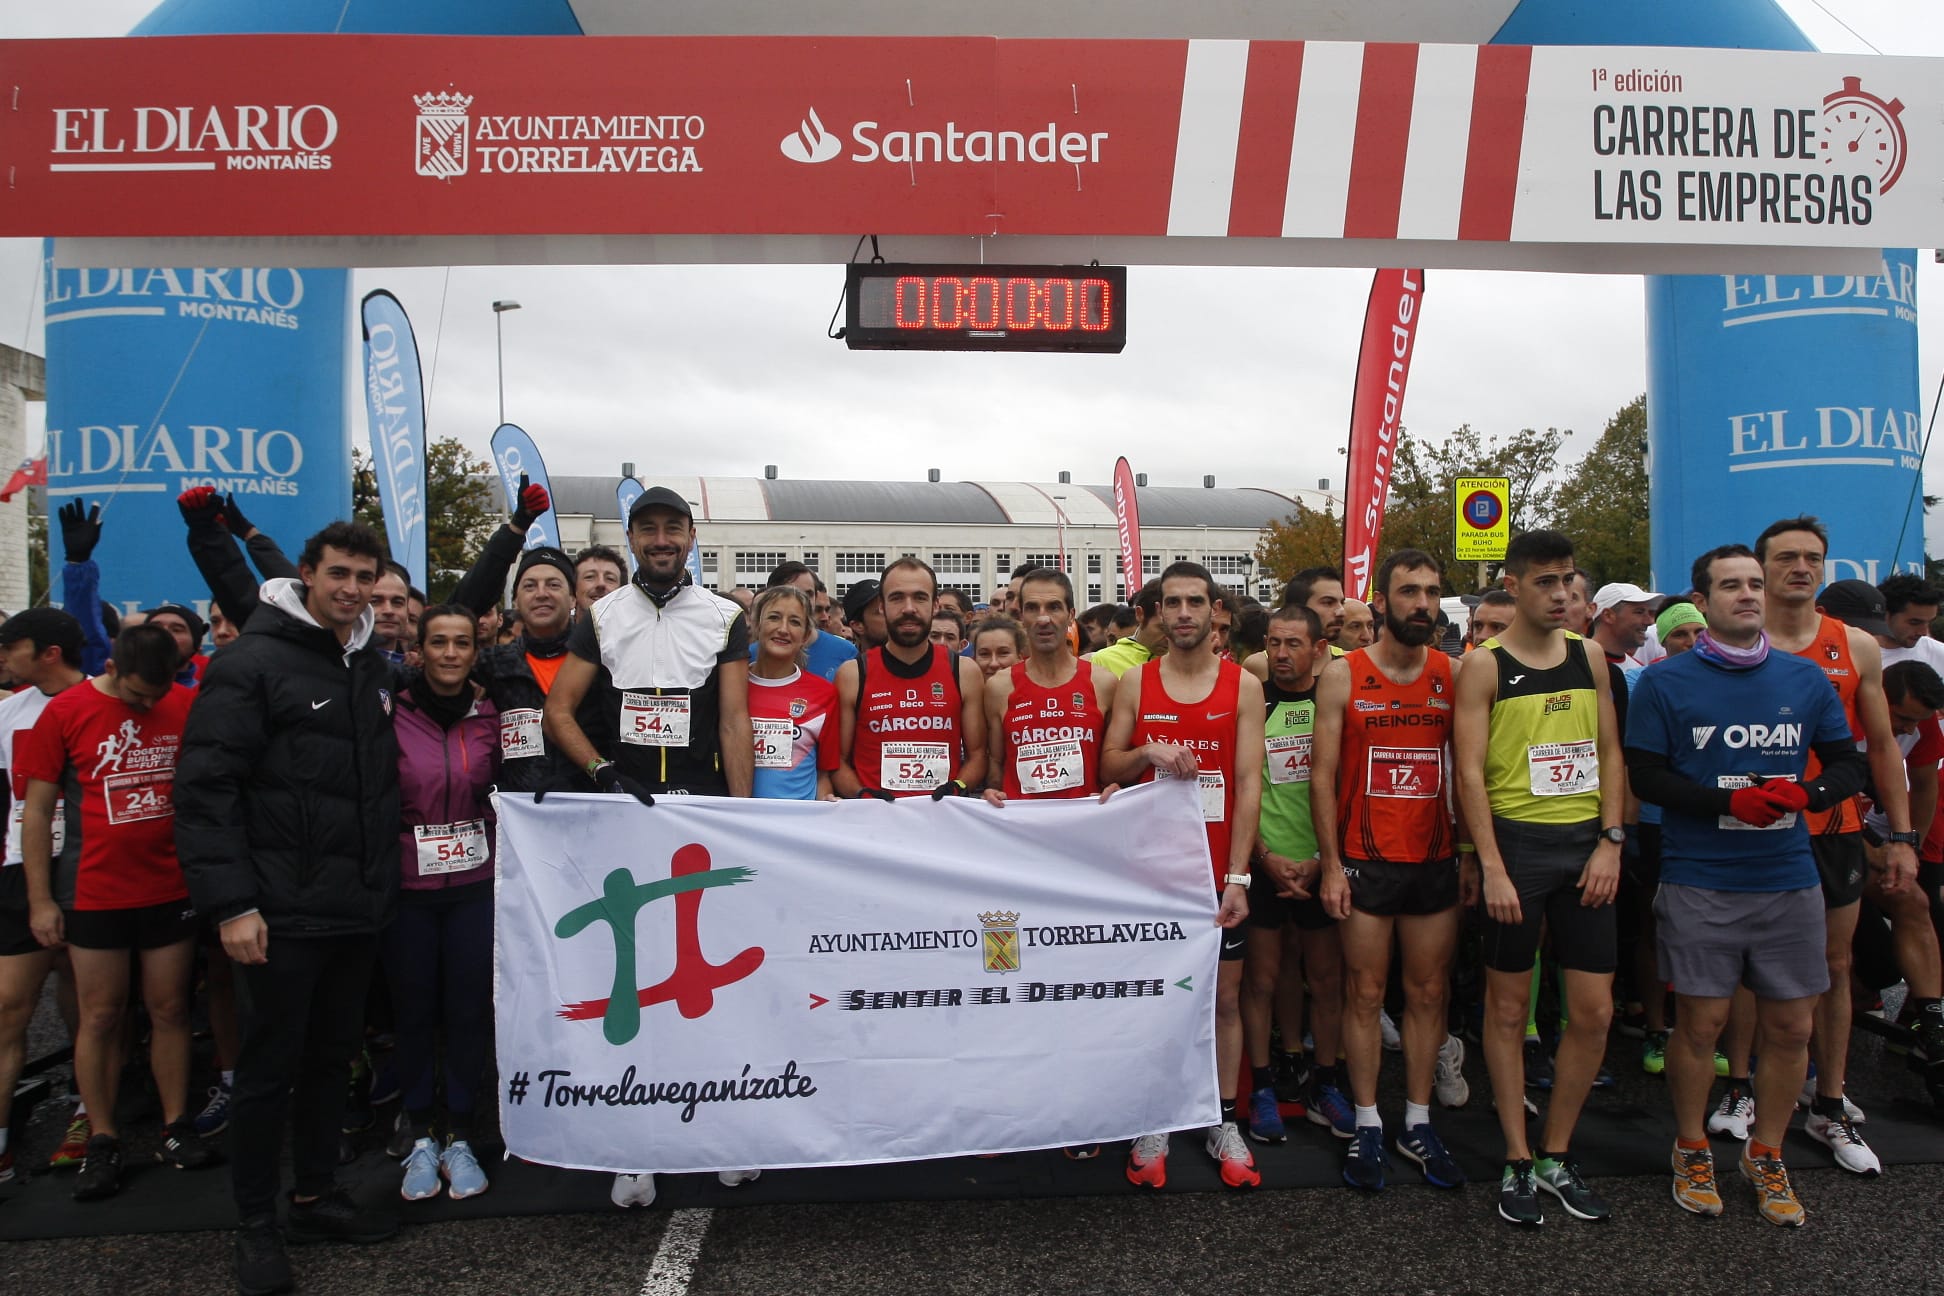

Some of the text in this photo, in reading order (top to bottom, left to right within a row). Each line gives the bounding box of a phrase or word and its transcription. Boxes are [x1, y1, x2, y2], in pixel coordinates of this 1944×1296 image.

[1591, 68, 1683, 93] 1ª edición
[51, 104, 338, 153] EL DIARIO
[475, 115, 705, 140] AYUNTAMIENTO
[1593, 105, 1816, 160] CARRERA DE
[422, 136, 431, 155] AVE
[453, 132, 462, 159] MARIA
[851, 121, 1109, 163] Santander
[227, 151, 332, 170] MONTAÑÉS
[475, 146, 704, 173] TORRELAVEGA
[1594, 169, 1872, 226] LAS EMPRESAS
[77, 268, 304, 310] DIARIO
[1720, 259, 1917, 311] EL DIAR
[179, 301, 298, 329] MONTAÑÉS
[1895, 305, 1917, 327] MONT
[1365, 269, 1417, 538] Santander
[1728, 406, 1923, 456] EL DIAR
[78, 424, 304, 478] DIARIO
[1901, 454, 1922, 471] MON
[635, 716, 673, 733] 54A
[869, 715, 952, 733] CÁRCOBA
[1040, 710, 1064, 718] Beco
[1365, 714, 1445, 730] REINOSA
[502, 731, 528, 749] 54B
[1011, 726, 1094, 744] CÁRCOBA
[1723, 723, 1802, 749] ORAN
[754, 739, 777, 754] 4D
[1532, 748, 1554, 757] CARRERA
[1562, 746, 1570, 754] LAS
[126, 753, 175, 764] BUILDING
[899, 763, 934, 778] 52A
[1031, 763, 1069, 779] 45A
[1389, 768, 1422, 785] 17A
[1550, 764, 1585, 782] 37A
[126, 790, 167, 809] 24D
[437, 842, 475, 861] 54C
[809, 930, 977, 953] AYUNTAMIENTO
[1023, 921, 1186, 946] TORRELAVEGA
[968, 986, 1011, 1005] EL
[1016, 979, 1165, 1003] DEPORTE
[538, 1060, 818, 1123] Torrelaveganízate
